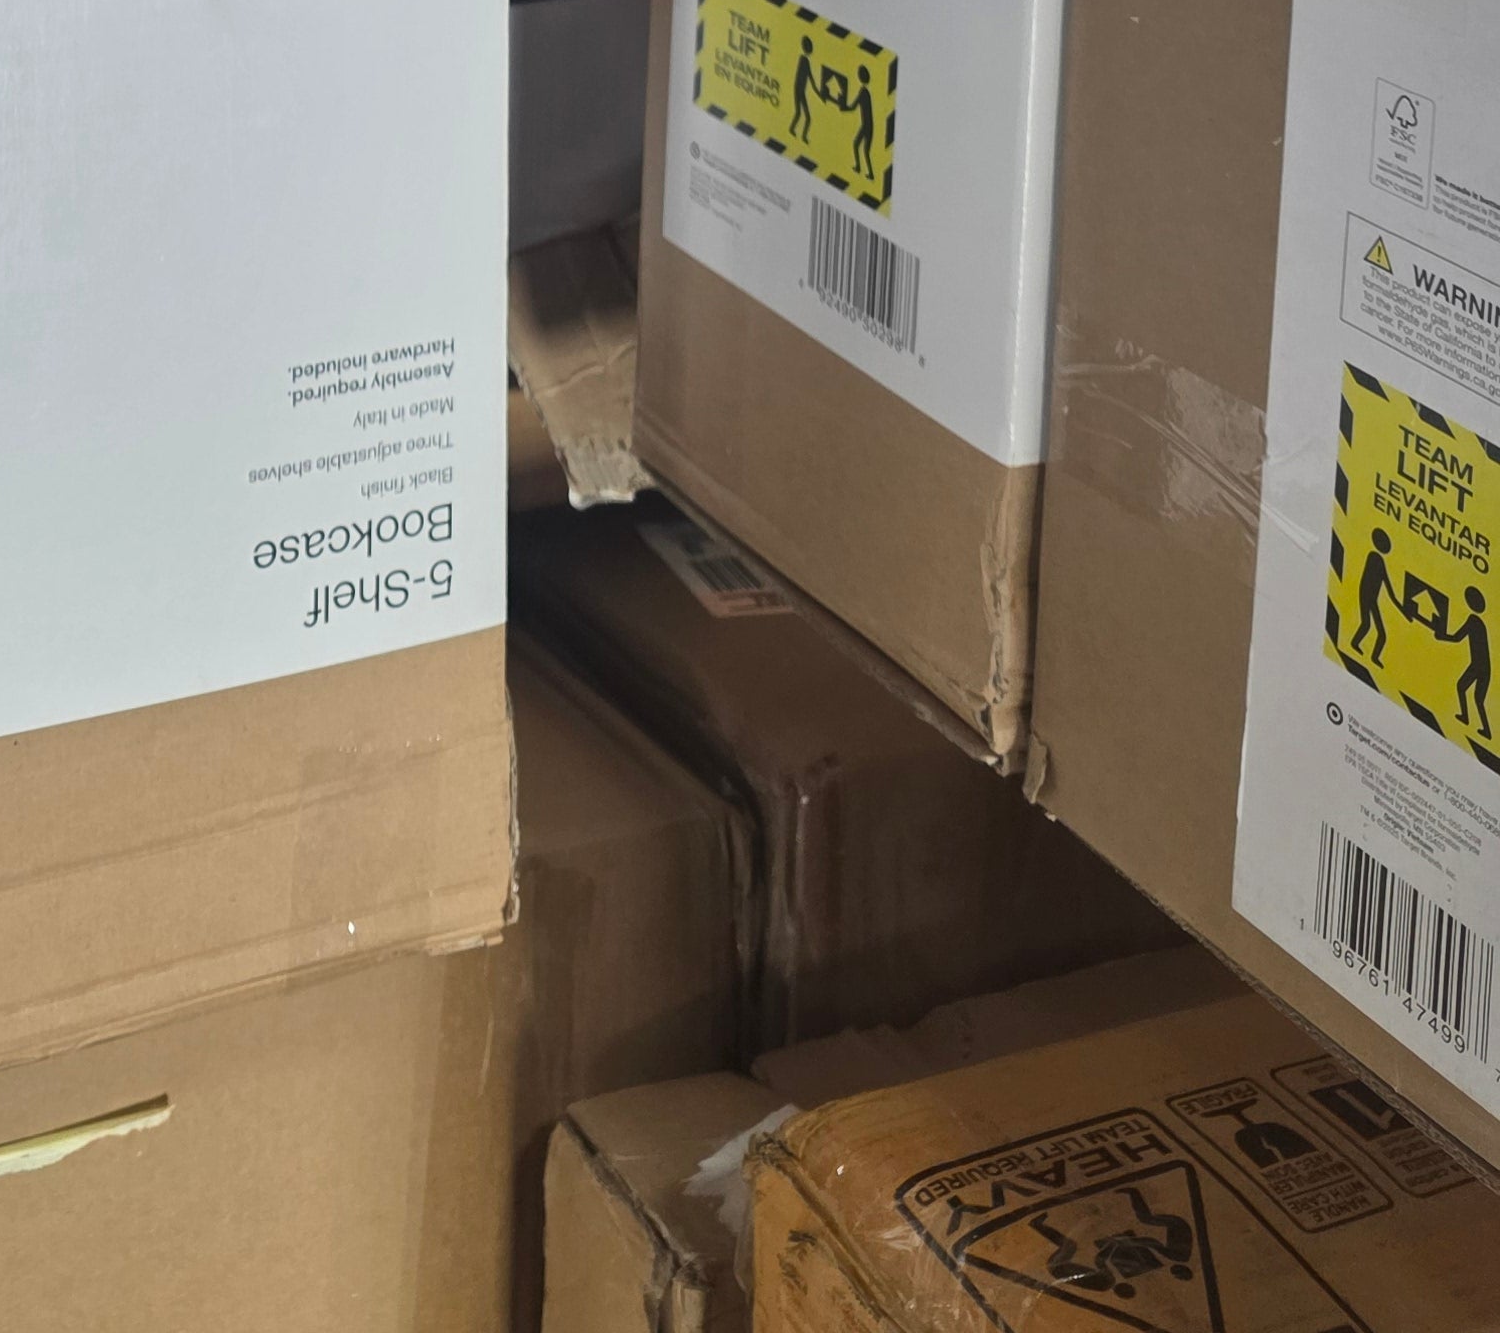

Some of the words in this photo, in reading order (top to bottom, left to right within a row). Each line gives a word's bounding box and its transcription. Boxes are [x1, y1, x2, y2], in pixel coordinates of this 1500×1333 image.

[729, 10, 770, 43] TEAM
[728, 29, 770, 66] LIFT
[1369, 265, 1390, 286] This
[1391, 280, 1431, 306] product
[1432, 300, 1452, 317] can
[1453, 312, 1497, 342] expose
[1363, 289, 1375, 302] to
[1372, 296, 1391, 311] the
[1393, 304, 1420, 327] State
[1421, 322, 1436, 334] of
[1434, 326, 1483, 360] California
[1485, 353, 1497, 367] to
[1397, 319, 1414, 336] For
[1415, 332, 1442, 352] more
[1454, 324, 1485, 347] which
[1487, 340, 1497, 354] is
[371, 338, 455, 364] Hardware
[288, 355, 367, 383] included.
[371, 361, 454, 390] Assembly
[288, 378, 367, 407] required.
[409, 396, 454, 418] Made
[353, 410, 387, 430] Italy
[391, 406, 405, 422] in
[316, 441, 402, 472] adjustable
[405, 432, 453, 452] Three
[1399, 425, 1473, 485] TEAM
[248, 459, 312, 483] shelves
[360, 476, 405, 499] finish
[409, 466, 453, 490] Black
[1397, 450, 1473, 512] LIFT
[1375, 473, 1490, 555] LEVANTAR
[253, 503, 453, 568] Bookcase
[1373, 492, 1401, 522] EN
[1408, 513, 1489, 574] EQUIPO
[304, 559, 453, 627] 5-Shelf
[1332, 940, 1389, 996] 96761
[1402, 997, 1469, 1054] 47499
[1174, 1075, 1260, 1121] FRAGILE
[1084, 1110, 1151, 1149] TEAM
[1028, 1131, 1087, 1166] LIFT
[907, 1148, 1034, 1213] REQUIRED
[933, 1124, 1176, 1235] HEAVY
